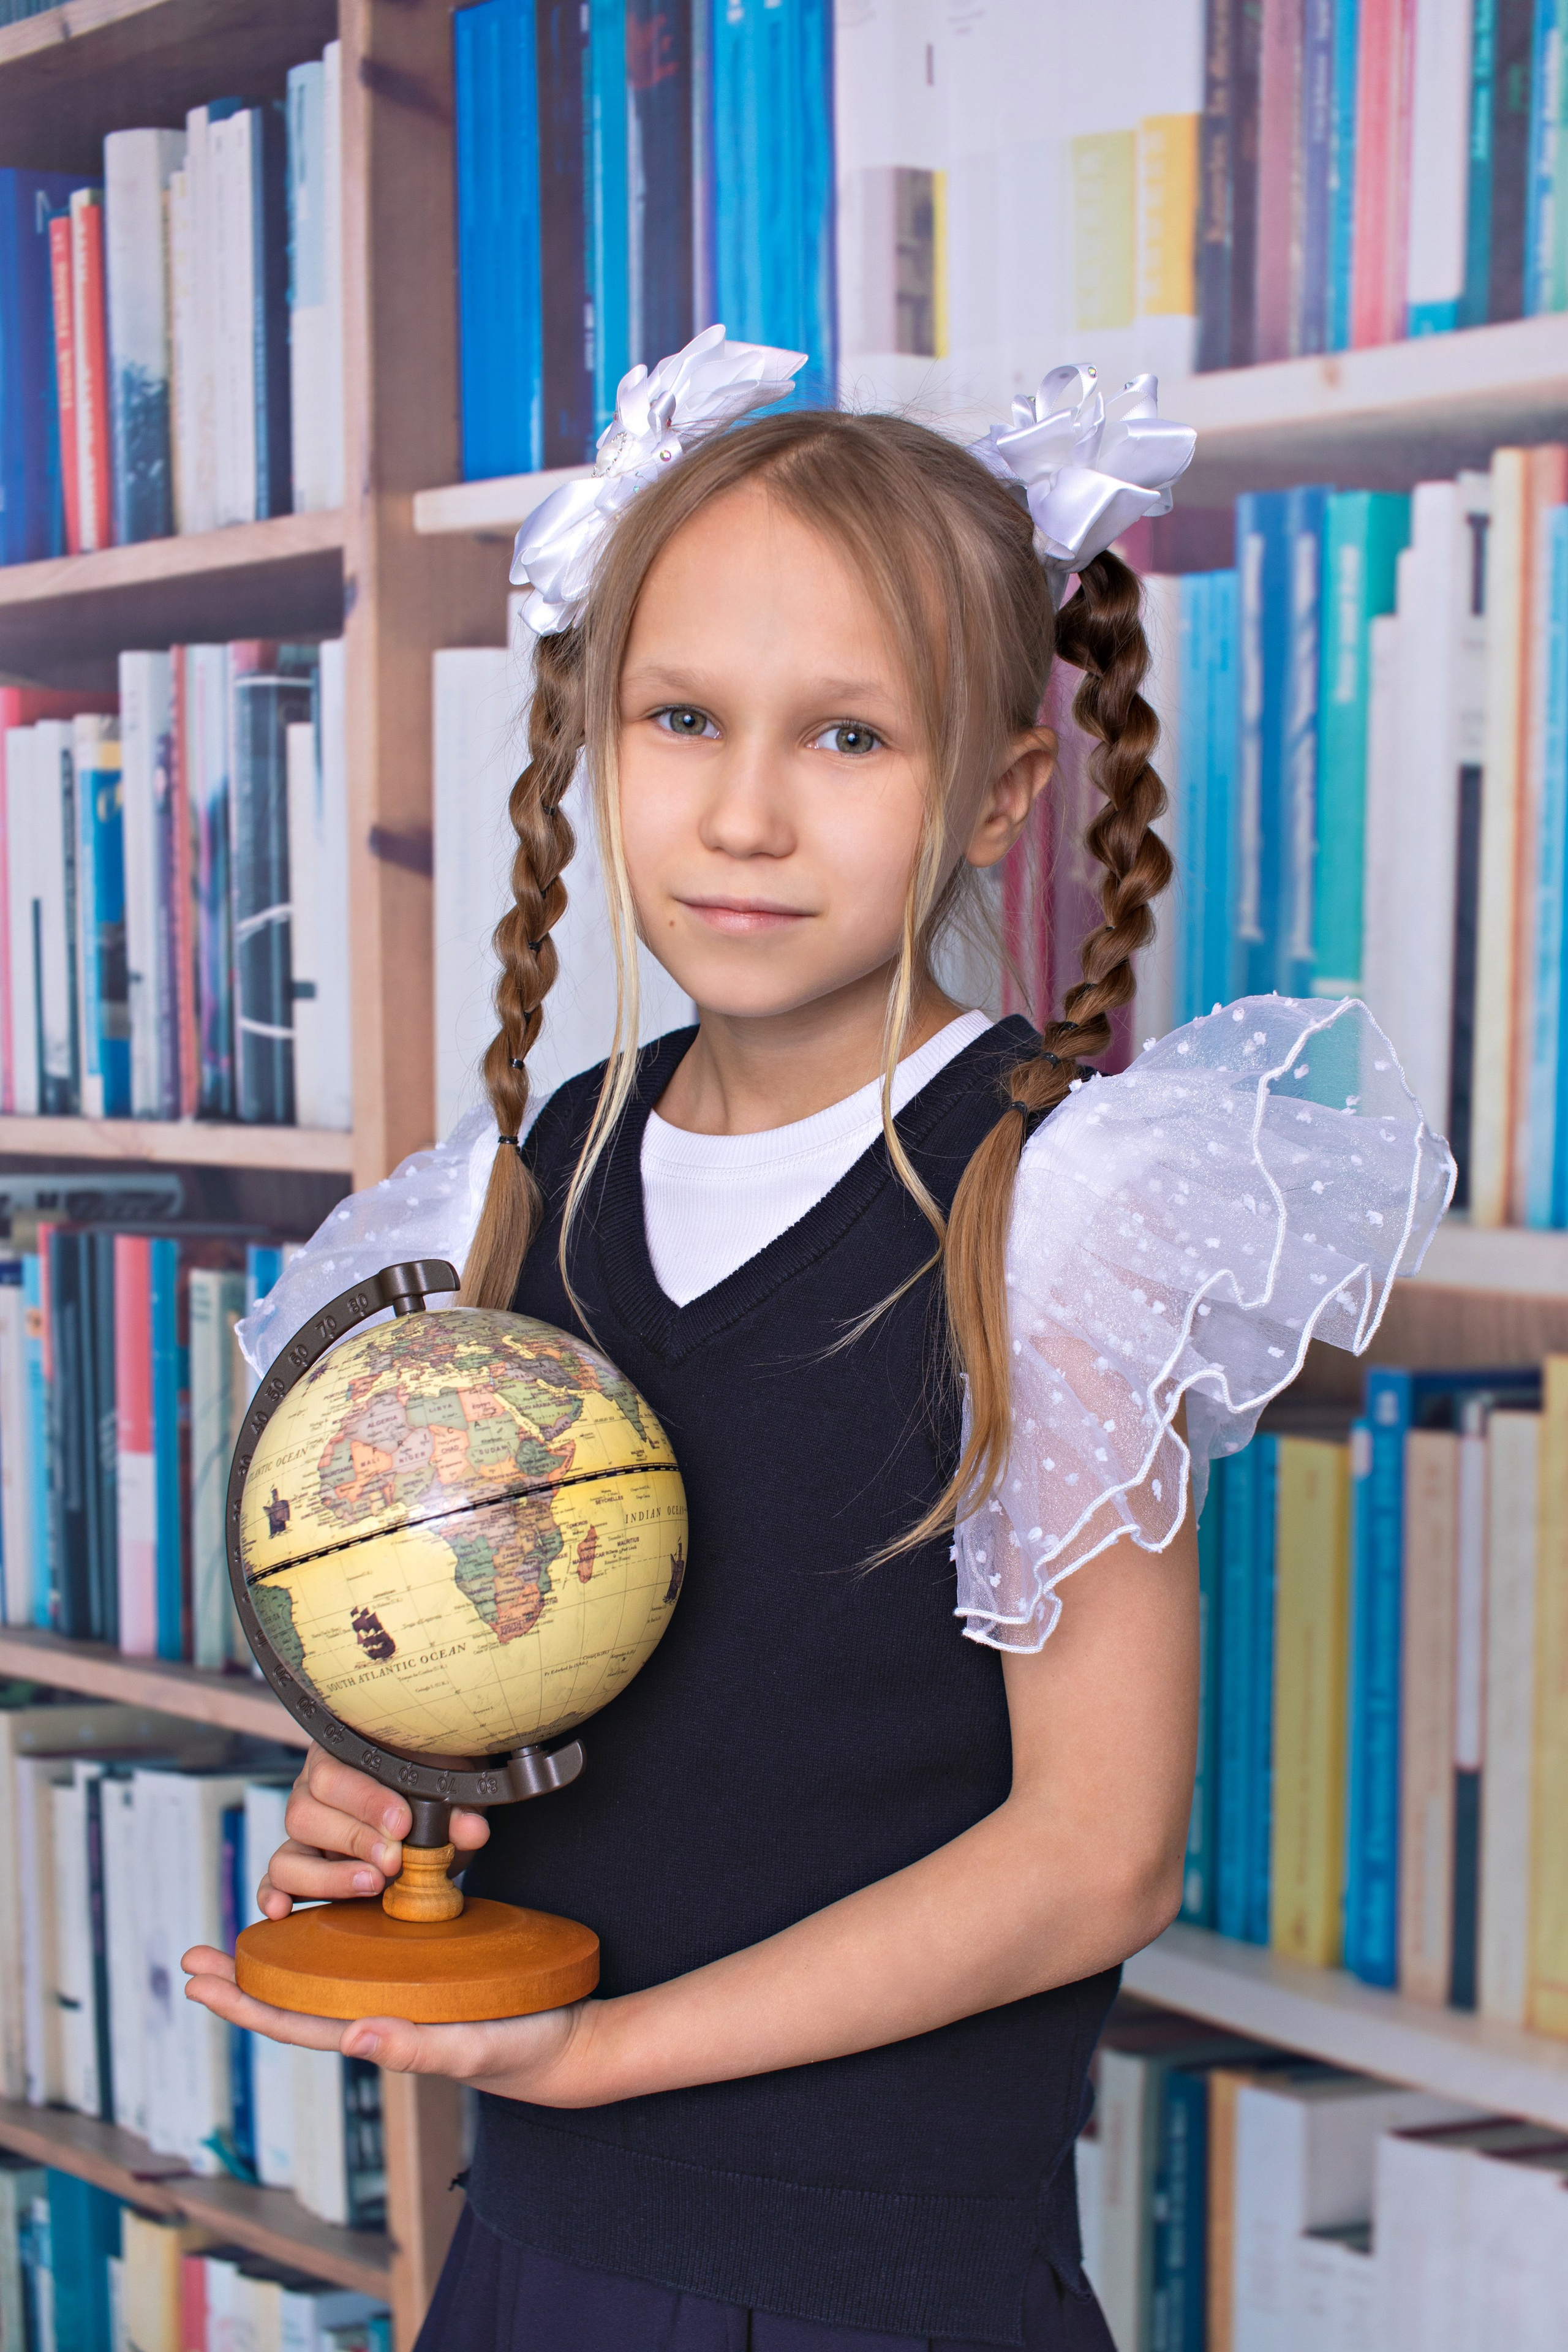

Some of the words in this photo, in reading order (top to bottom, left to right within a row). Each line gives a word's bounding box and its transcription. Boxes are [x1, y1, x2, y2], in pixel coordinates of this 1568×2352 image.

[347, 1293, 368, 1314] 80
[315, 1316, 336, 1338] 70
[288, 1344, 307, 1366] 60
[265, 1378, 284, 1401] 50
[429, 1403, 454, 1414] LIBYA
[472, 1401, 491, 1410] EGYPT
[251, 1411, 268, 1434] 40
[368, 1415, 398, 1428] ALGERIA
[441, 1445, 459, 1453] CHAD
[479, 1445, 508, 1455] SUDAN
[276, 1446, 309, 1468] OCEAN
[361, 1457, 380, 1467] MALI
[399, 1452, 426, 1463] NIGER
[595, 1495, 624, 1505] SEYCHELLES
[625, 1507, 662, 1524] INDIAN
[566, 1520, 589, 1529] COMOROS
[617, 1536, 639, 1547] MAURITIUS
[572, 1551, 605, 1565] MADAGASCAR
[500, 1622, 522, 1630] SOUTH
[500, 1627, 523, 1636] AFRICA
[326, 1677, 355, 1692] SOUTH
[358, 1659, 417, 1684] ATLANTIC
[420, 1643, 467, 1664] OCEAN
[273, 1665, 293, 1687] 20
[296, 1697, 316, 1719] 30
[324, 1724, 344, 1744] 40
[361, 1751, 382, 1771] 50
[398, 1767, 418, 1785] 60
[436, 1779, 457, 1794] 70
[477, 1778, 497, 1794] 80
